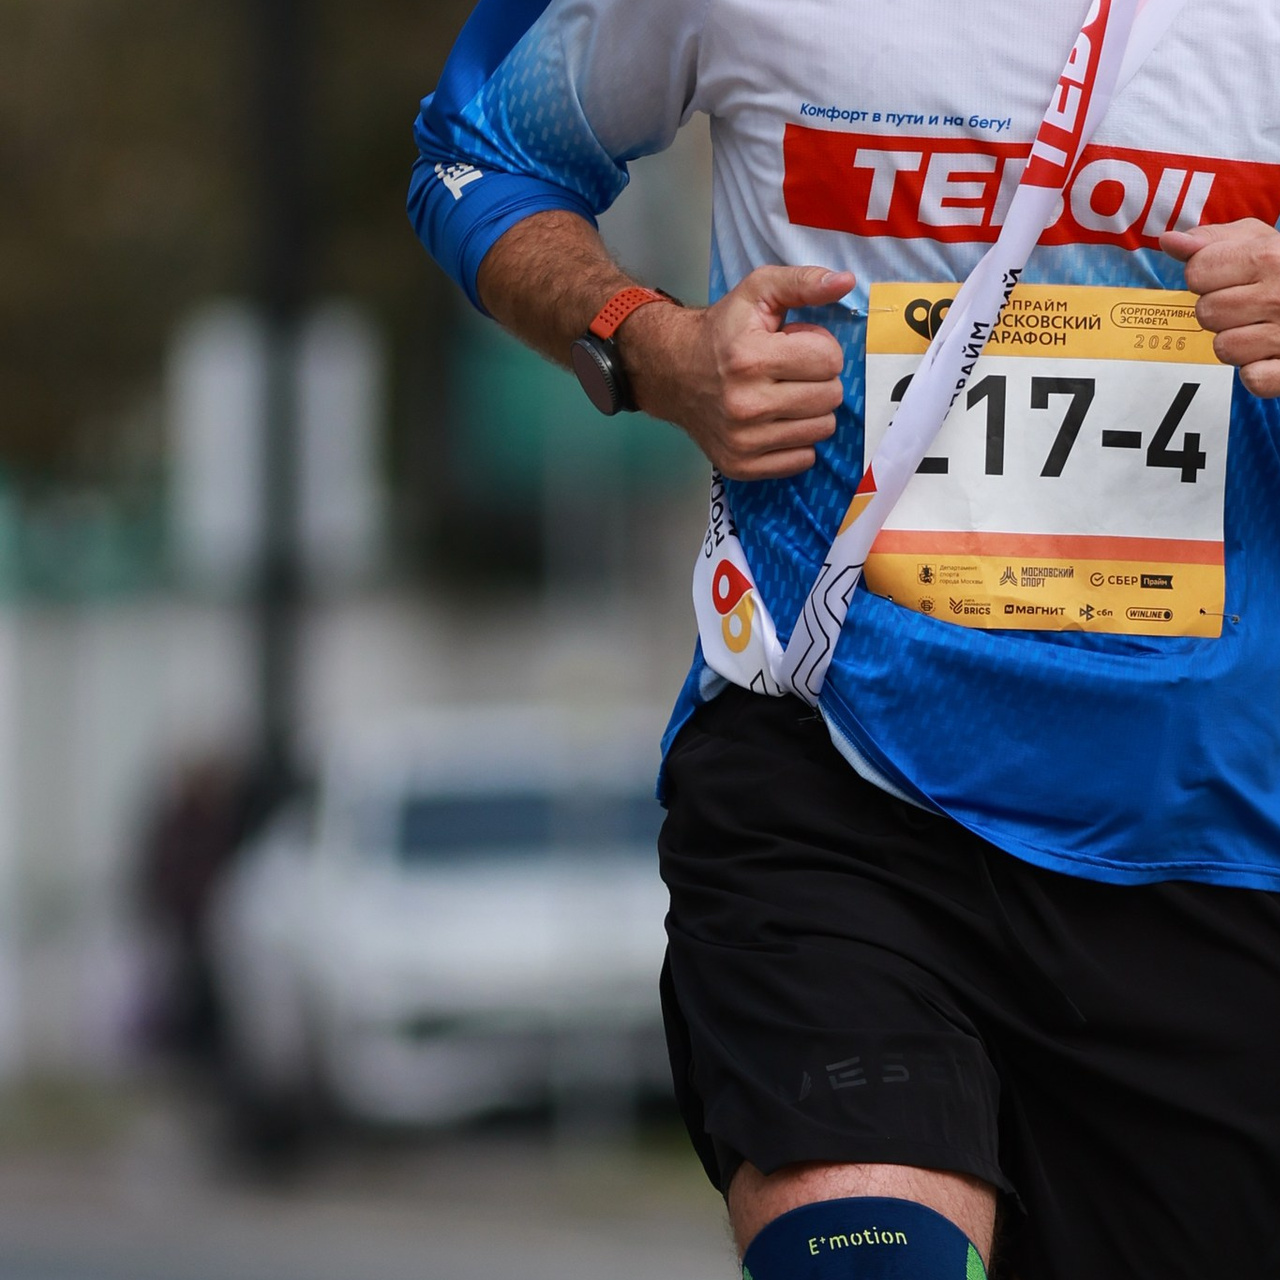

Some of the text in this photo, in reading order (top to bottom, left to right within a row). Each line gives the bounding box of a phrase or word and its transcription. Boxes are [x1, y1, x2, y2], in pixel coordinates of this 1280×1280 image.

[800, 103, 1011, 132] Комфорт в пути и на бегу!
[1120, 307, 1196, 319] КОРПОРАТИВНА
[1120, 316, 1168, 326] ЭСТАФЕТА
[987, 330, 1067, 346] АРАФОН
[1134, 334, 1187, 351] 2026
[1021, 566, 1074, 579] МОСКОВСКИЙ
[1021, 577, 1046, 588] СПОРТ
[1107, 575, 1139, 586] СБЕР
[964, 606, 991, 615] BRICS
[1016, 605, 1066, 616] магнит
[1096, 609, 1113, 617] сбп
[1129, 609, 1163, 619] WINLINE
